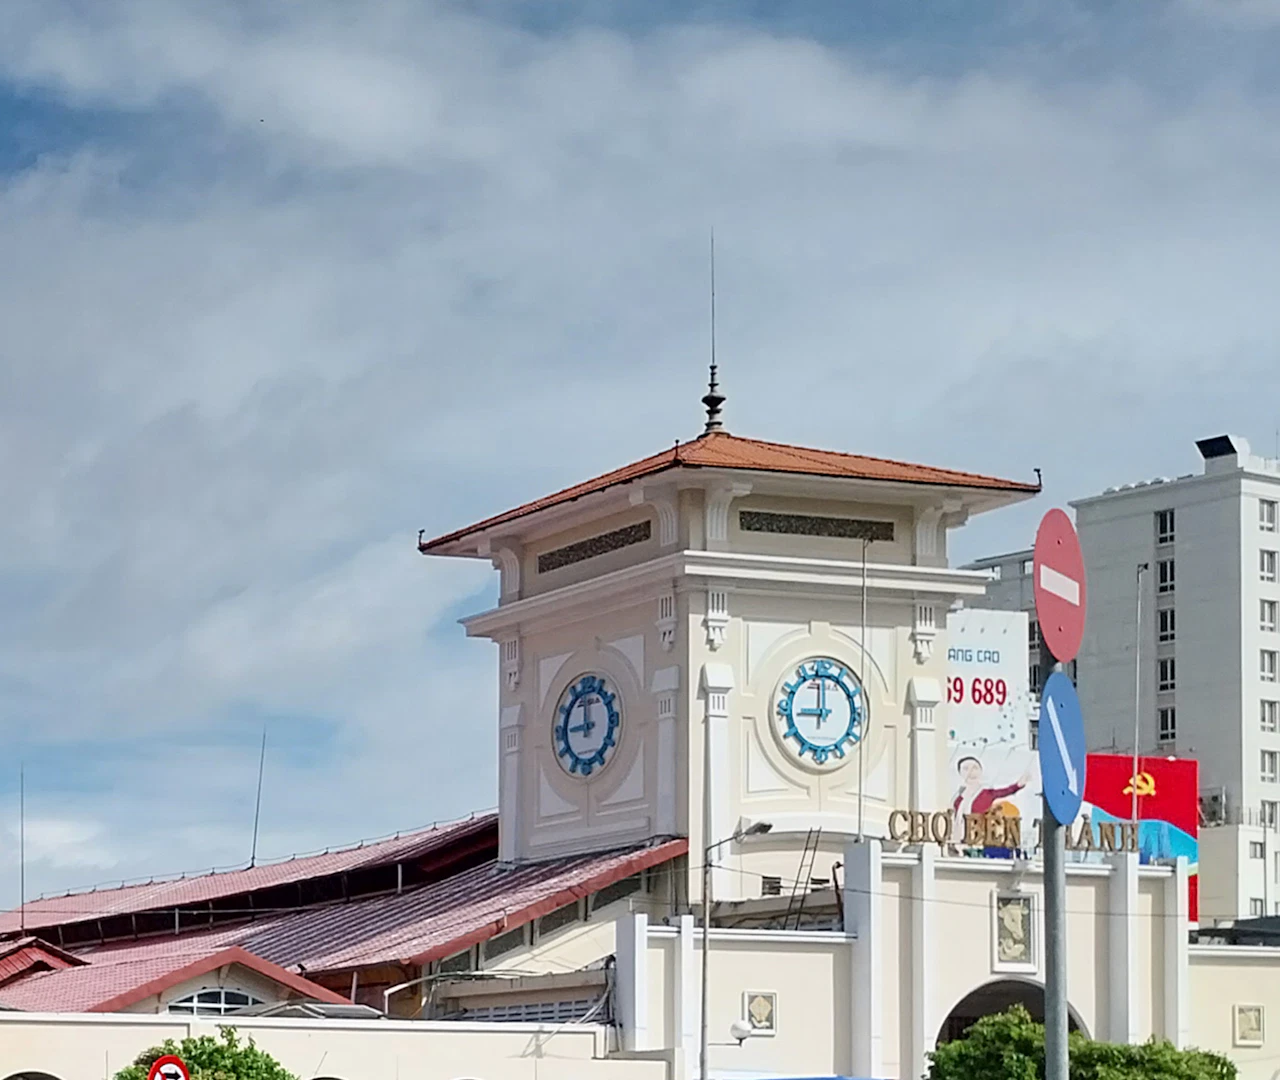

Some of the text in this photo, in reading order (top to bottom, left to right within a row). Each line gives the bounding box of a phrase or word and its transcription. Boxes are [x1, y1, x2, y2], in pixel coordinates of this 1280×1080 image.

[971, 677, 1007, 706] 689
[889, 808, 954, 846] CHỢ
[962, 804, 1022, 848] BẾN
